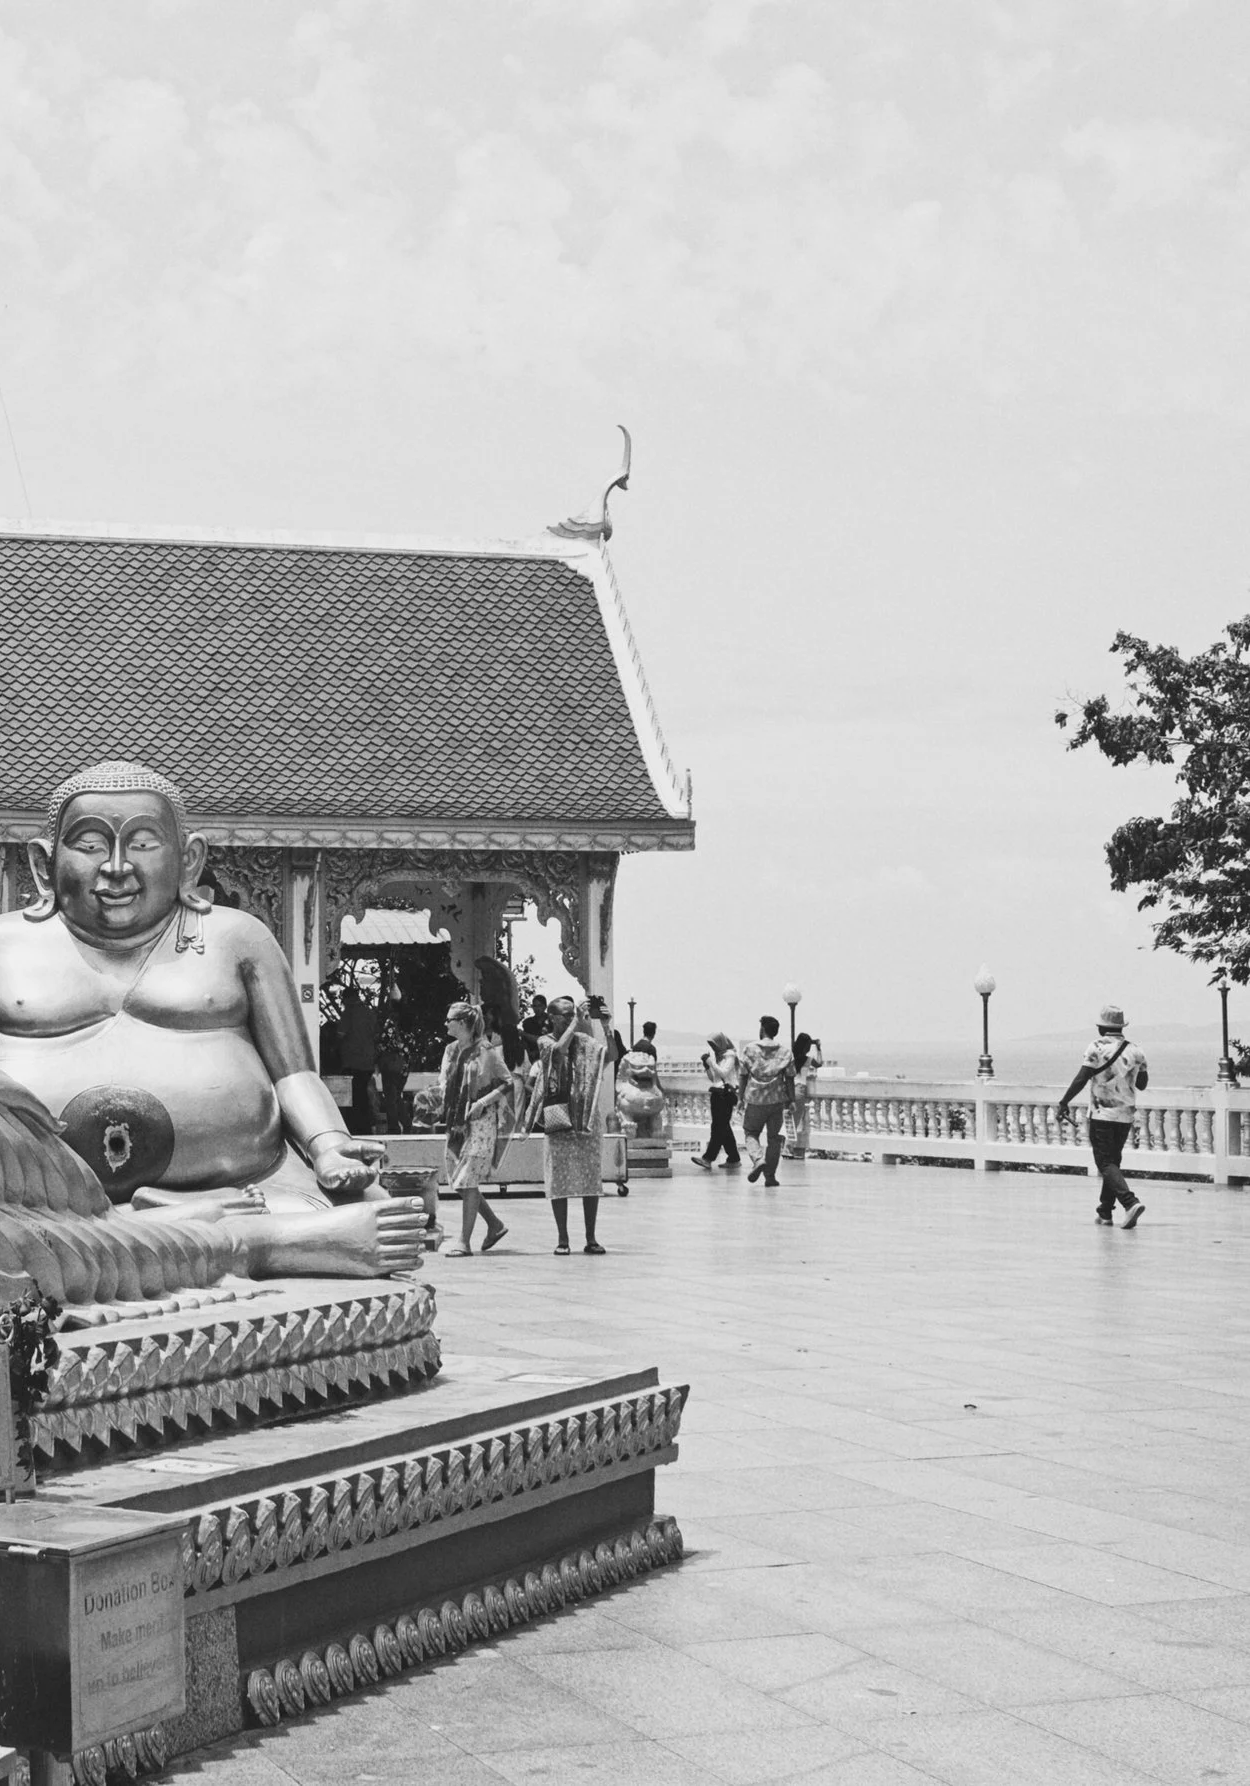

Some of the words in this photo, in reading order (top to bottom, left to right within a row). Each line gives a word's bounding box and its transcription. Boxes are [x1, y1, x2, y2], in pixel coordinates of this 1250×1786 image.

[84, 1581, 147, 1616] Donation
[151, 1571, 175, 1594] Box
[100, 1627, 132, 1653] Make
